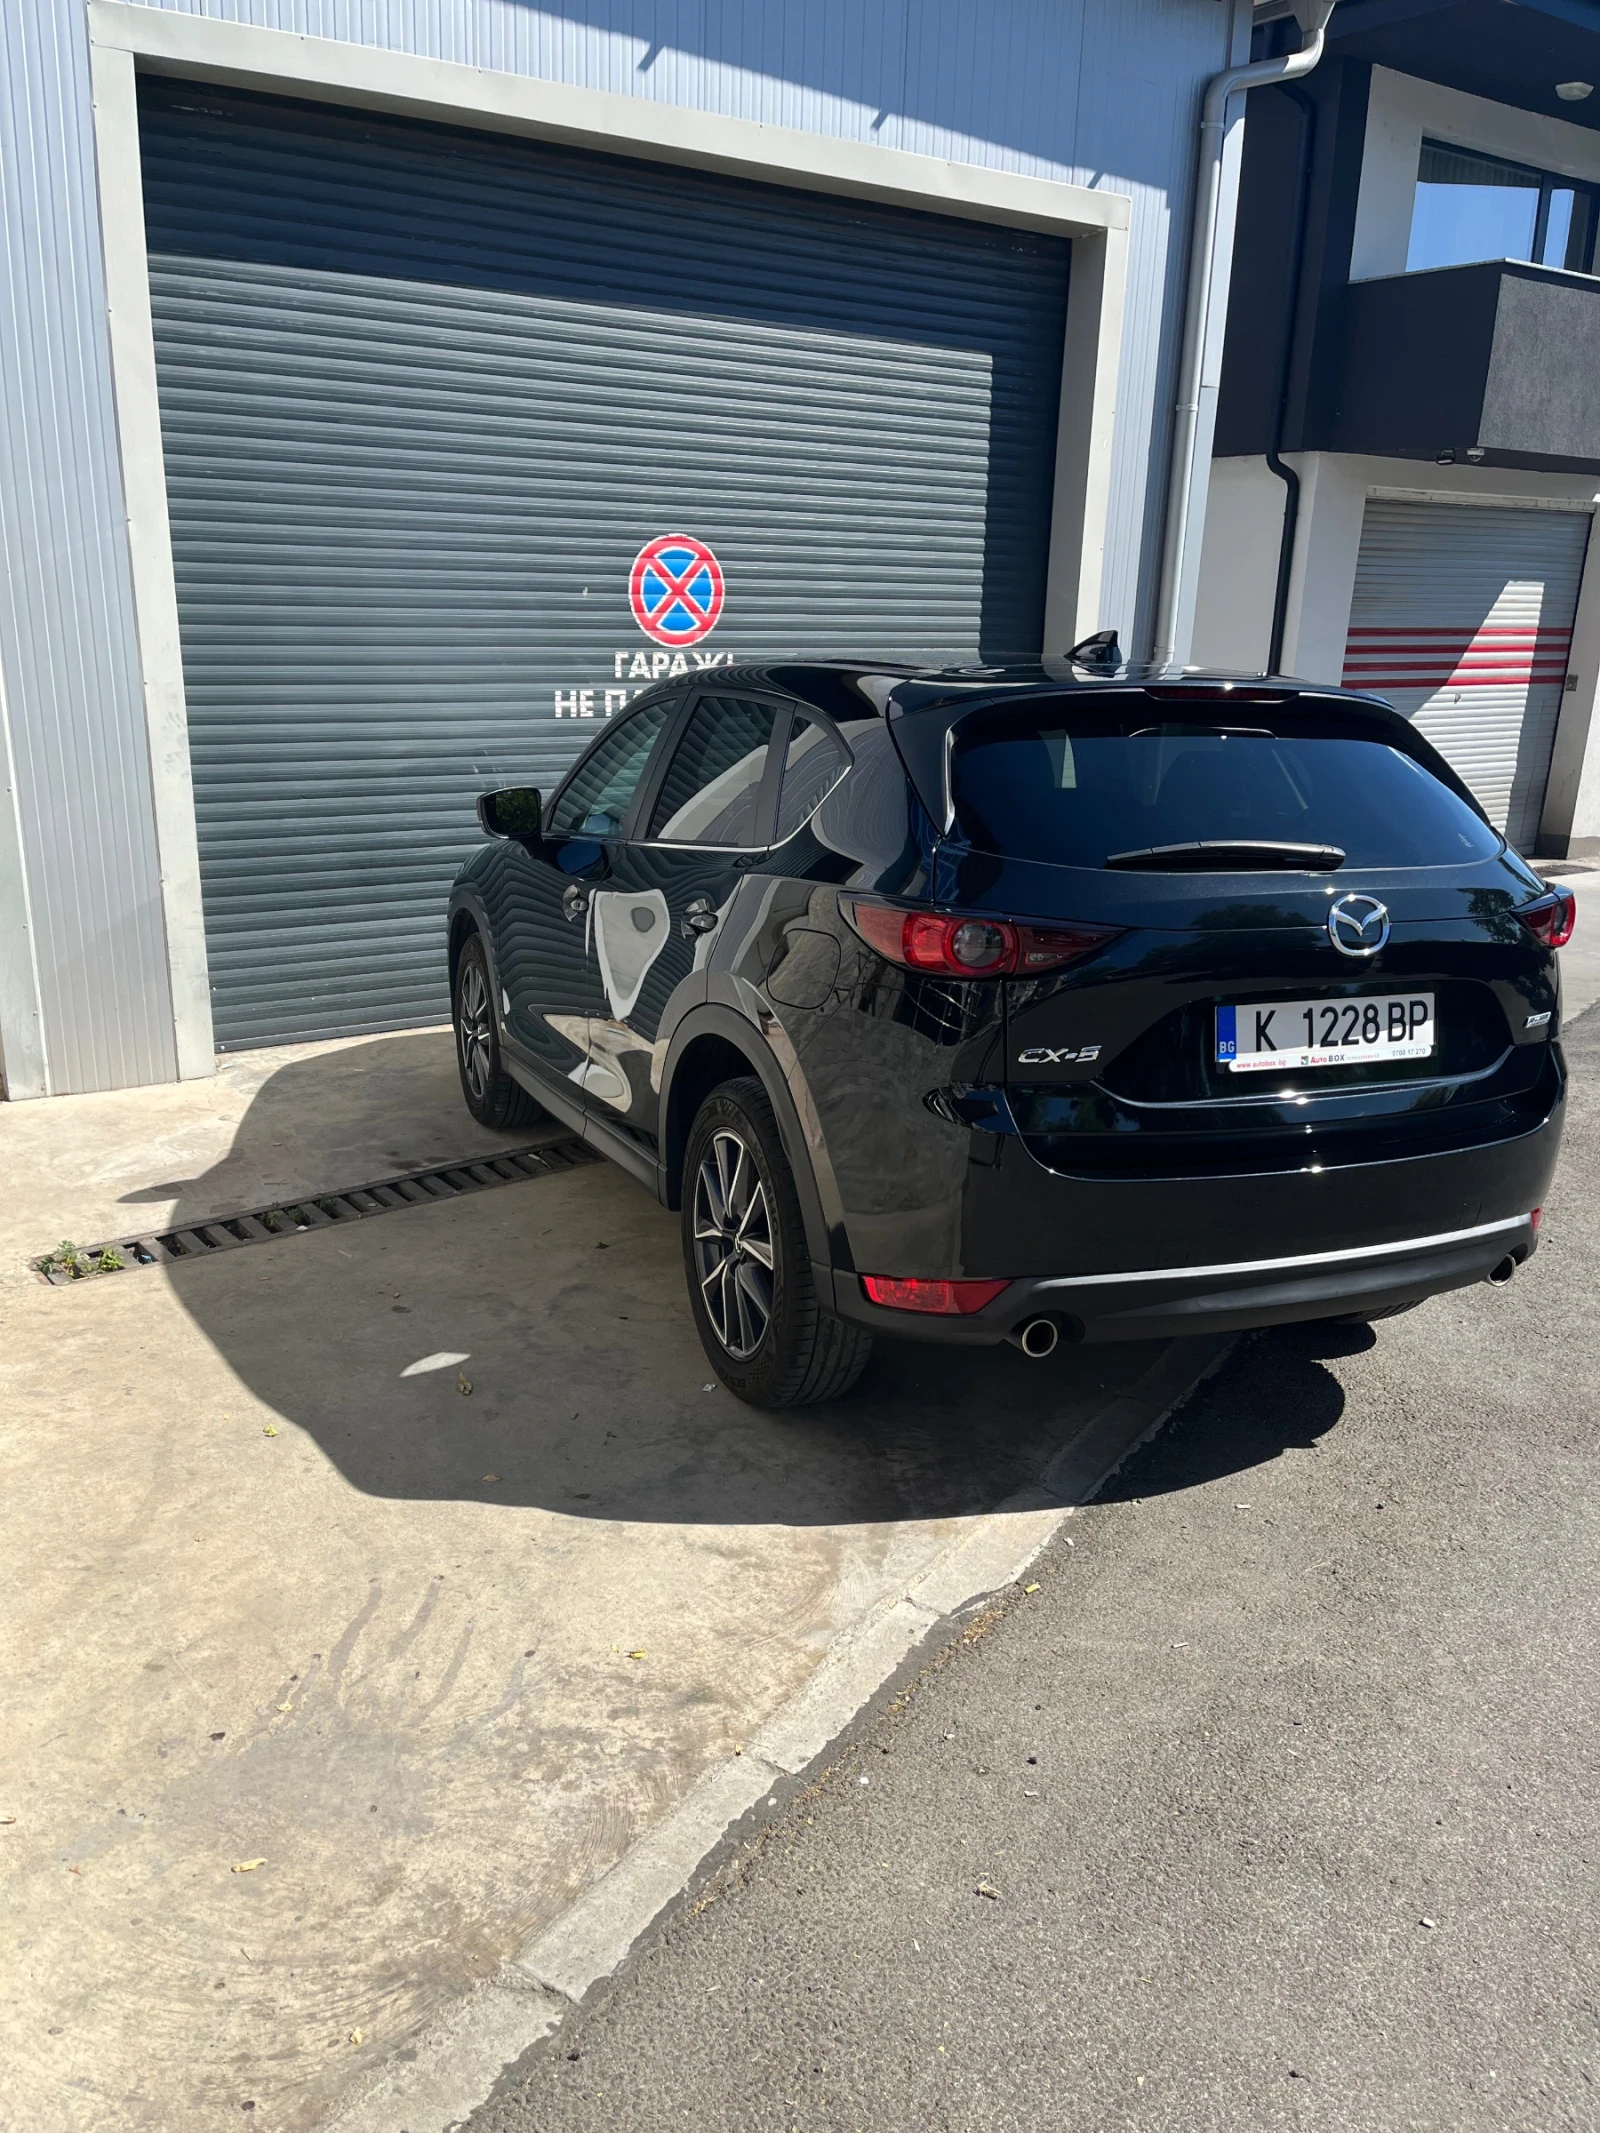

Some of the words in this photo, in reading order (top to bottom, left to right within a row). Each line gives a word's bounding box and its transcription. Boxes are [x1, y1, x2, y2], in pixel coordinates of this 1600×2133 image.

[554, 689, 594, 718] НЕ
[1255, 1010, 1277, 1052] K
[1303, 1004, 1380, 1049] 1228
[1388, 1000, 1429, 1042] BP
[1018, 1045, 1102, 1063] CX-5
[1219, 1040, 1235, 1054] BG
[1328, 1054, 1345, 1062] BOX
